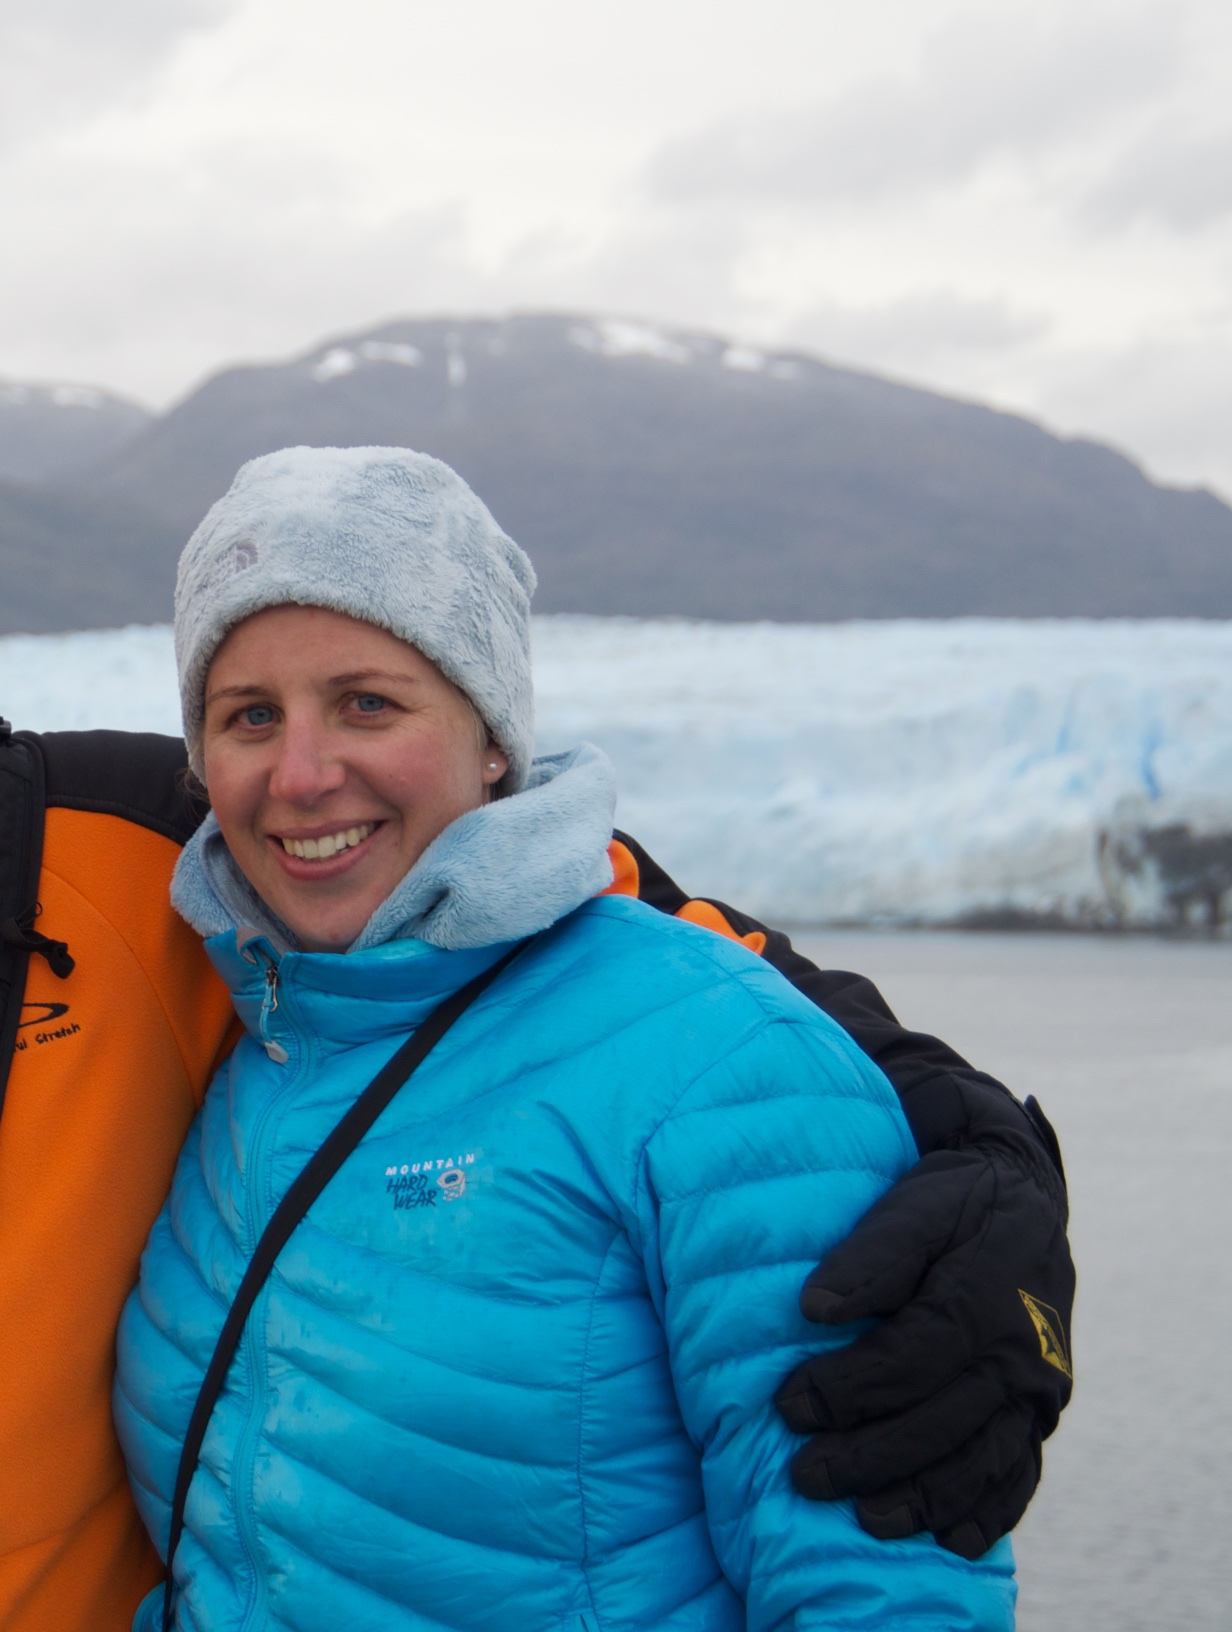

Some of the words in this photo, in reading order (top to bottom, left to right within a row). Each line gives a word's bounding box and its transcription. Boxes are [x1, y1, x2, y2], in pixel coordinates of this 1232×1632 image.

[385, 1153, 475, 1176] MOUNTAIN
[386, 1174, 429, 1194] HARD
[393, 1190, 437, 1210] WEAR
